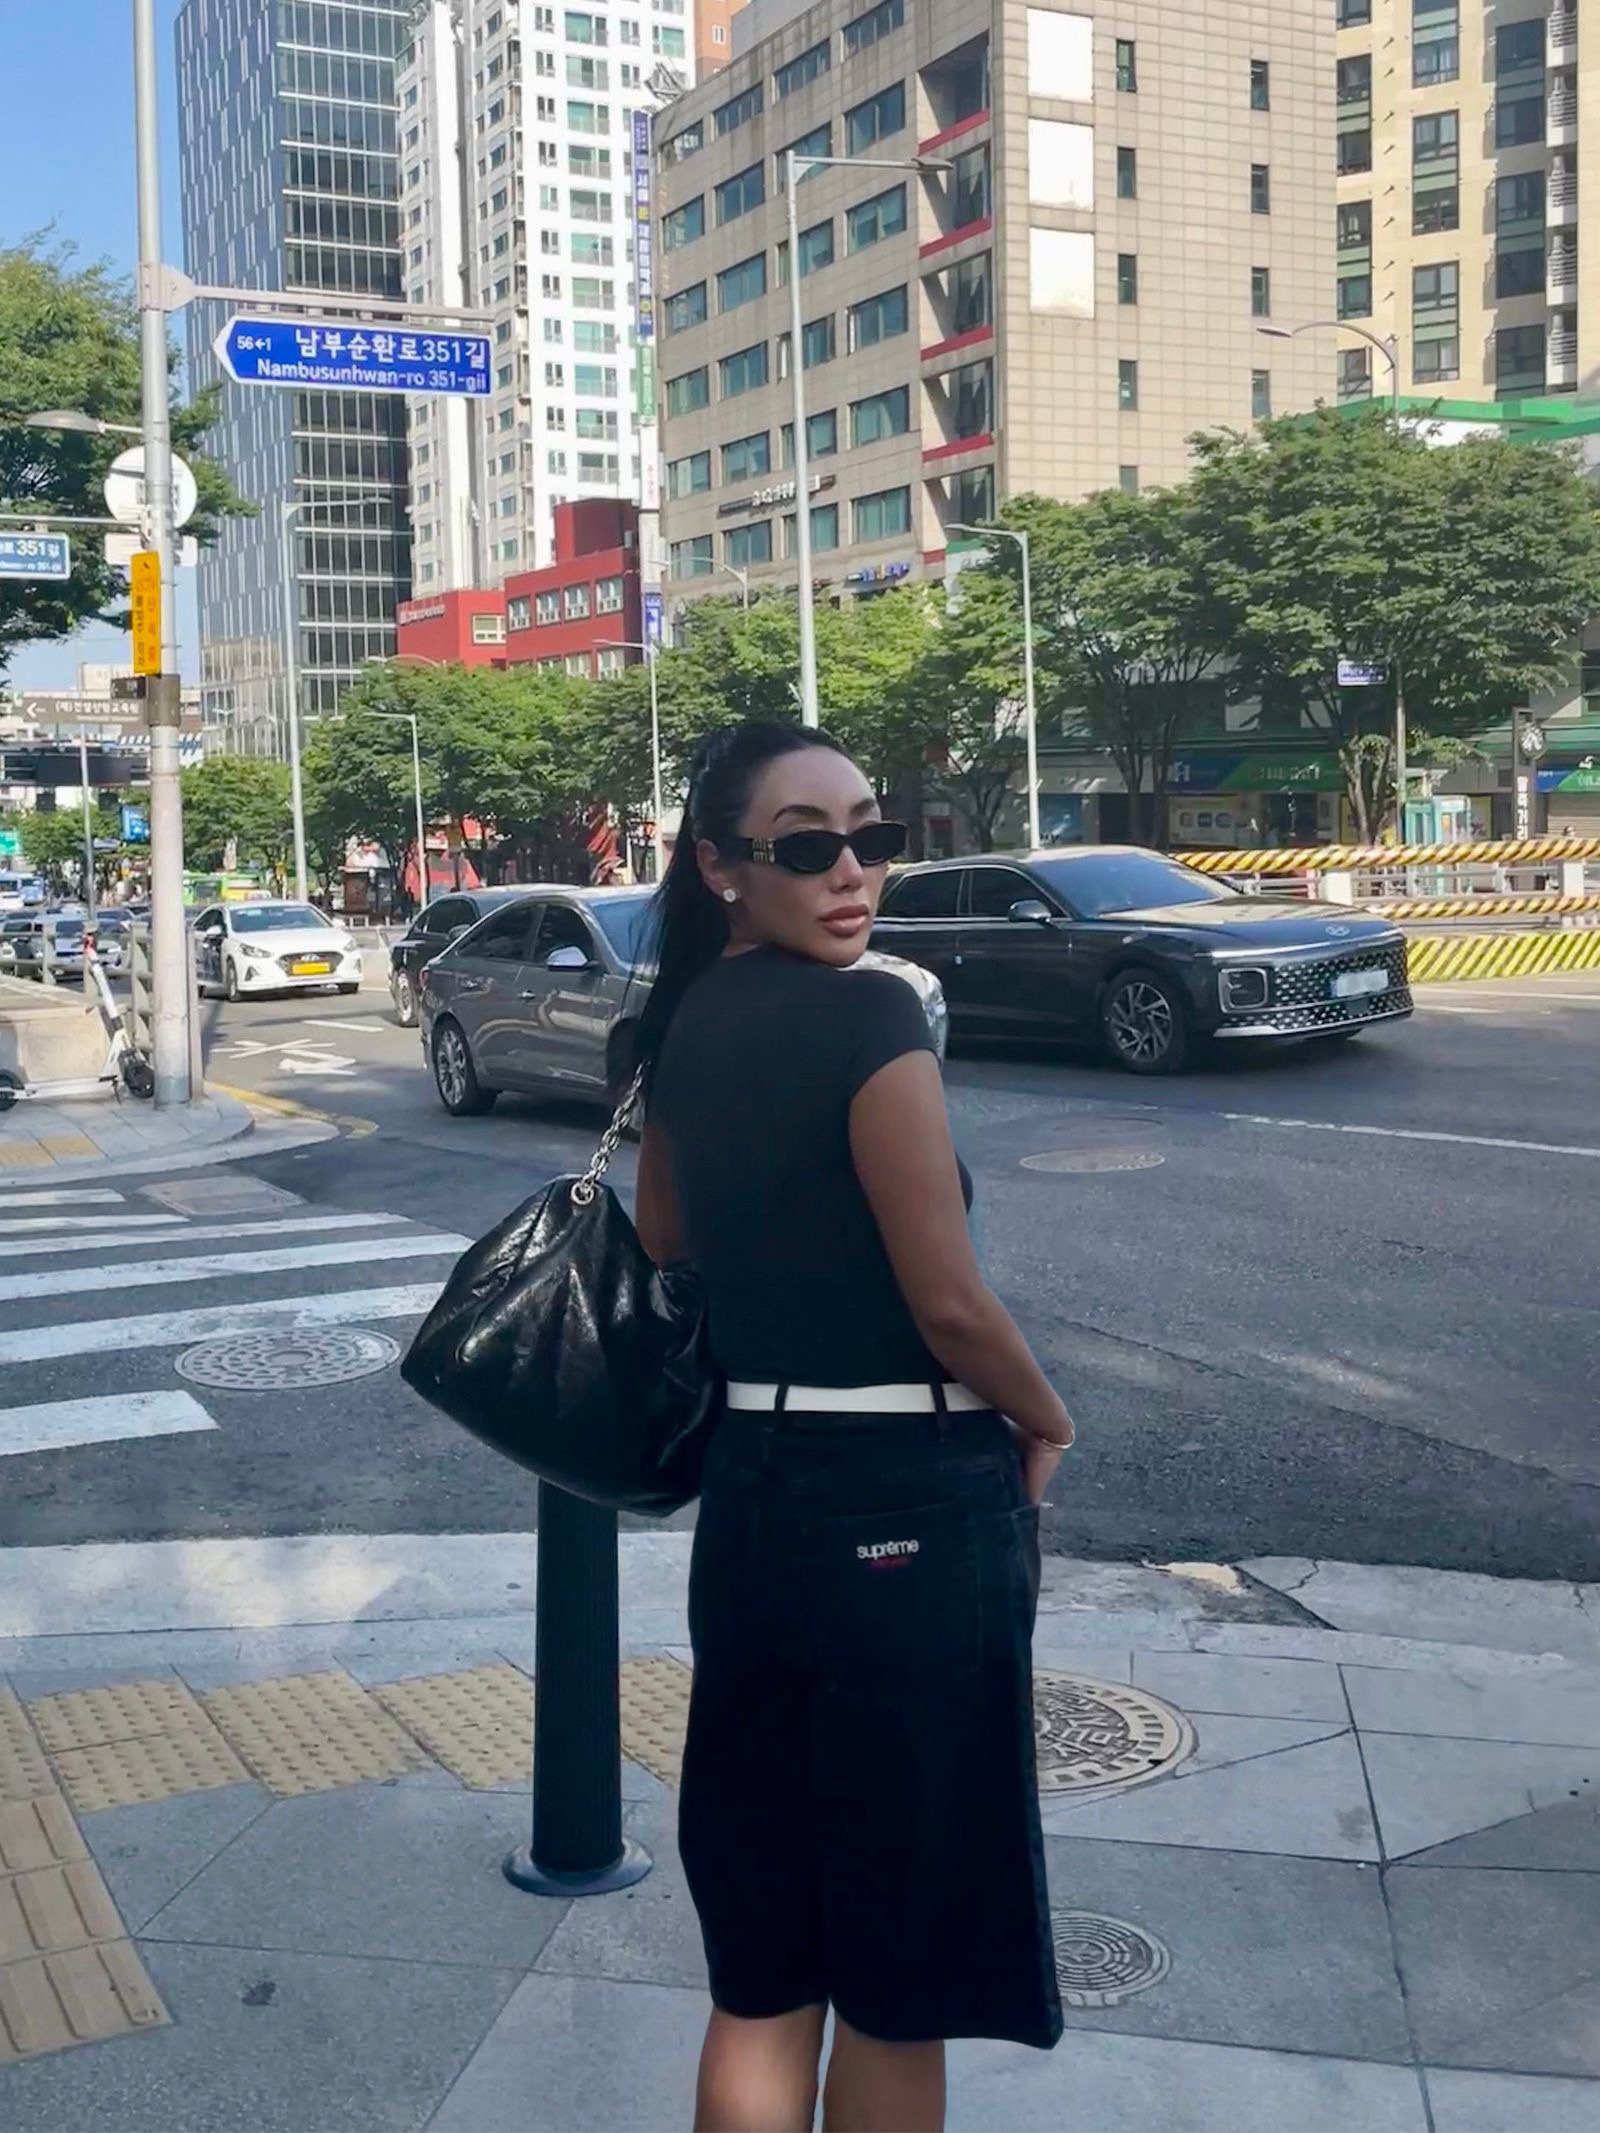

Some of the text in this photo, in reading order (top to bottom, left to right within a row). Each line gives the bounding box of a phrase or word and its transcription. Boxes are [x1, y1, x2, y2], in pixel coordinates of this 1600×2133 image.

[294, 328, 487, 369] 남부순환로351길
[257, 358, 487, 393] Nambusunhwan-ro 351-gil
